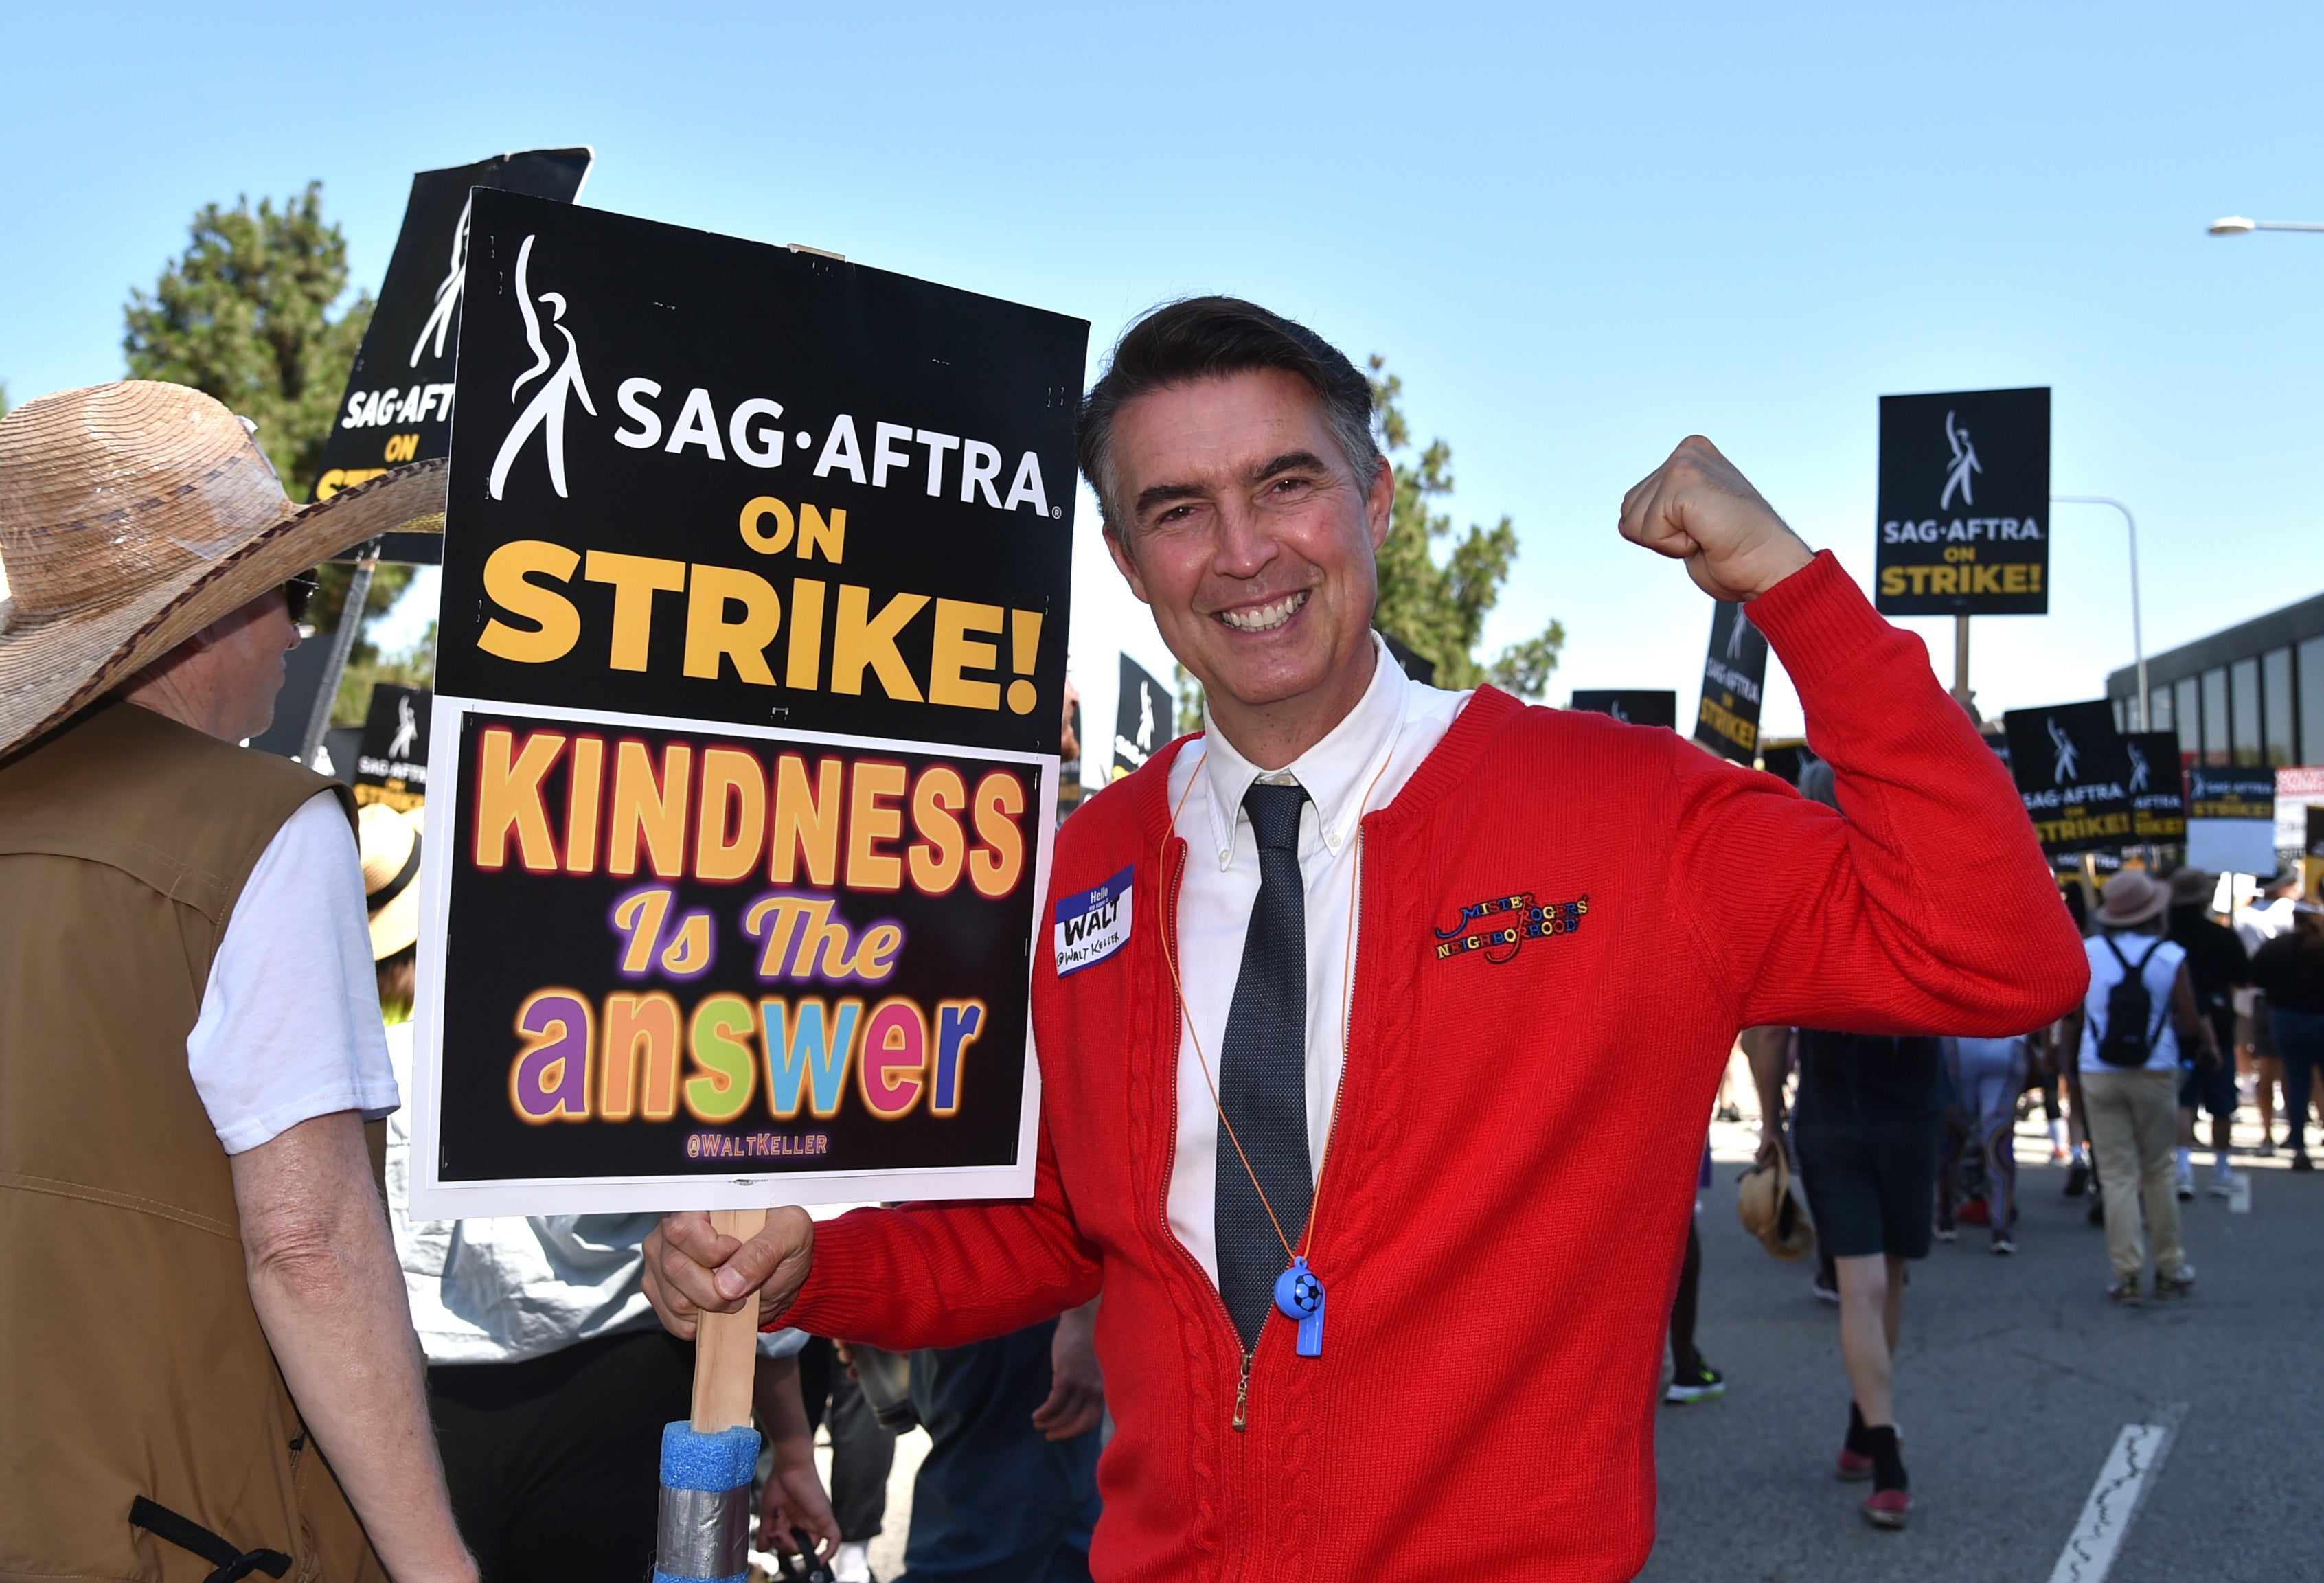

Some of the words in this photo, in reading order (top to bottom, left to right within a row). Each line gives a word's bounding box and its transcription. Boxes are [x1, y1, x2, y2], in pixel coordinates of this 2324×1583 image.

[384, 433, 420, 462] ON
[739, 496, 847, 565] ON
[1944, 546, 1976, 562] ON
[1881, 563, 2042, 596] STRIKE!
[477, 540, 1044, 716] STRIKE!
[475, 729, 1025, 897] KINDNESS
[1091, 886, 1108, 904] Hello
[1436, 893, 1536, 938] MISTER
[613, 889, 711, 974] Is
[744, 896, 903, 979] The
[1064, 893, 1120, 946] WALT
[1436, 918, 1580, 961] NEIGHBORHOOD
[1056, 947, 1089, 967] @WALT
[1091, 931, 1119, 955] KELLER
[516, 994, 983, 1118] answer
